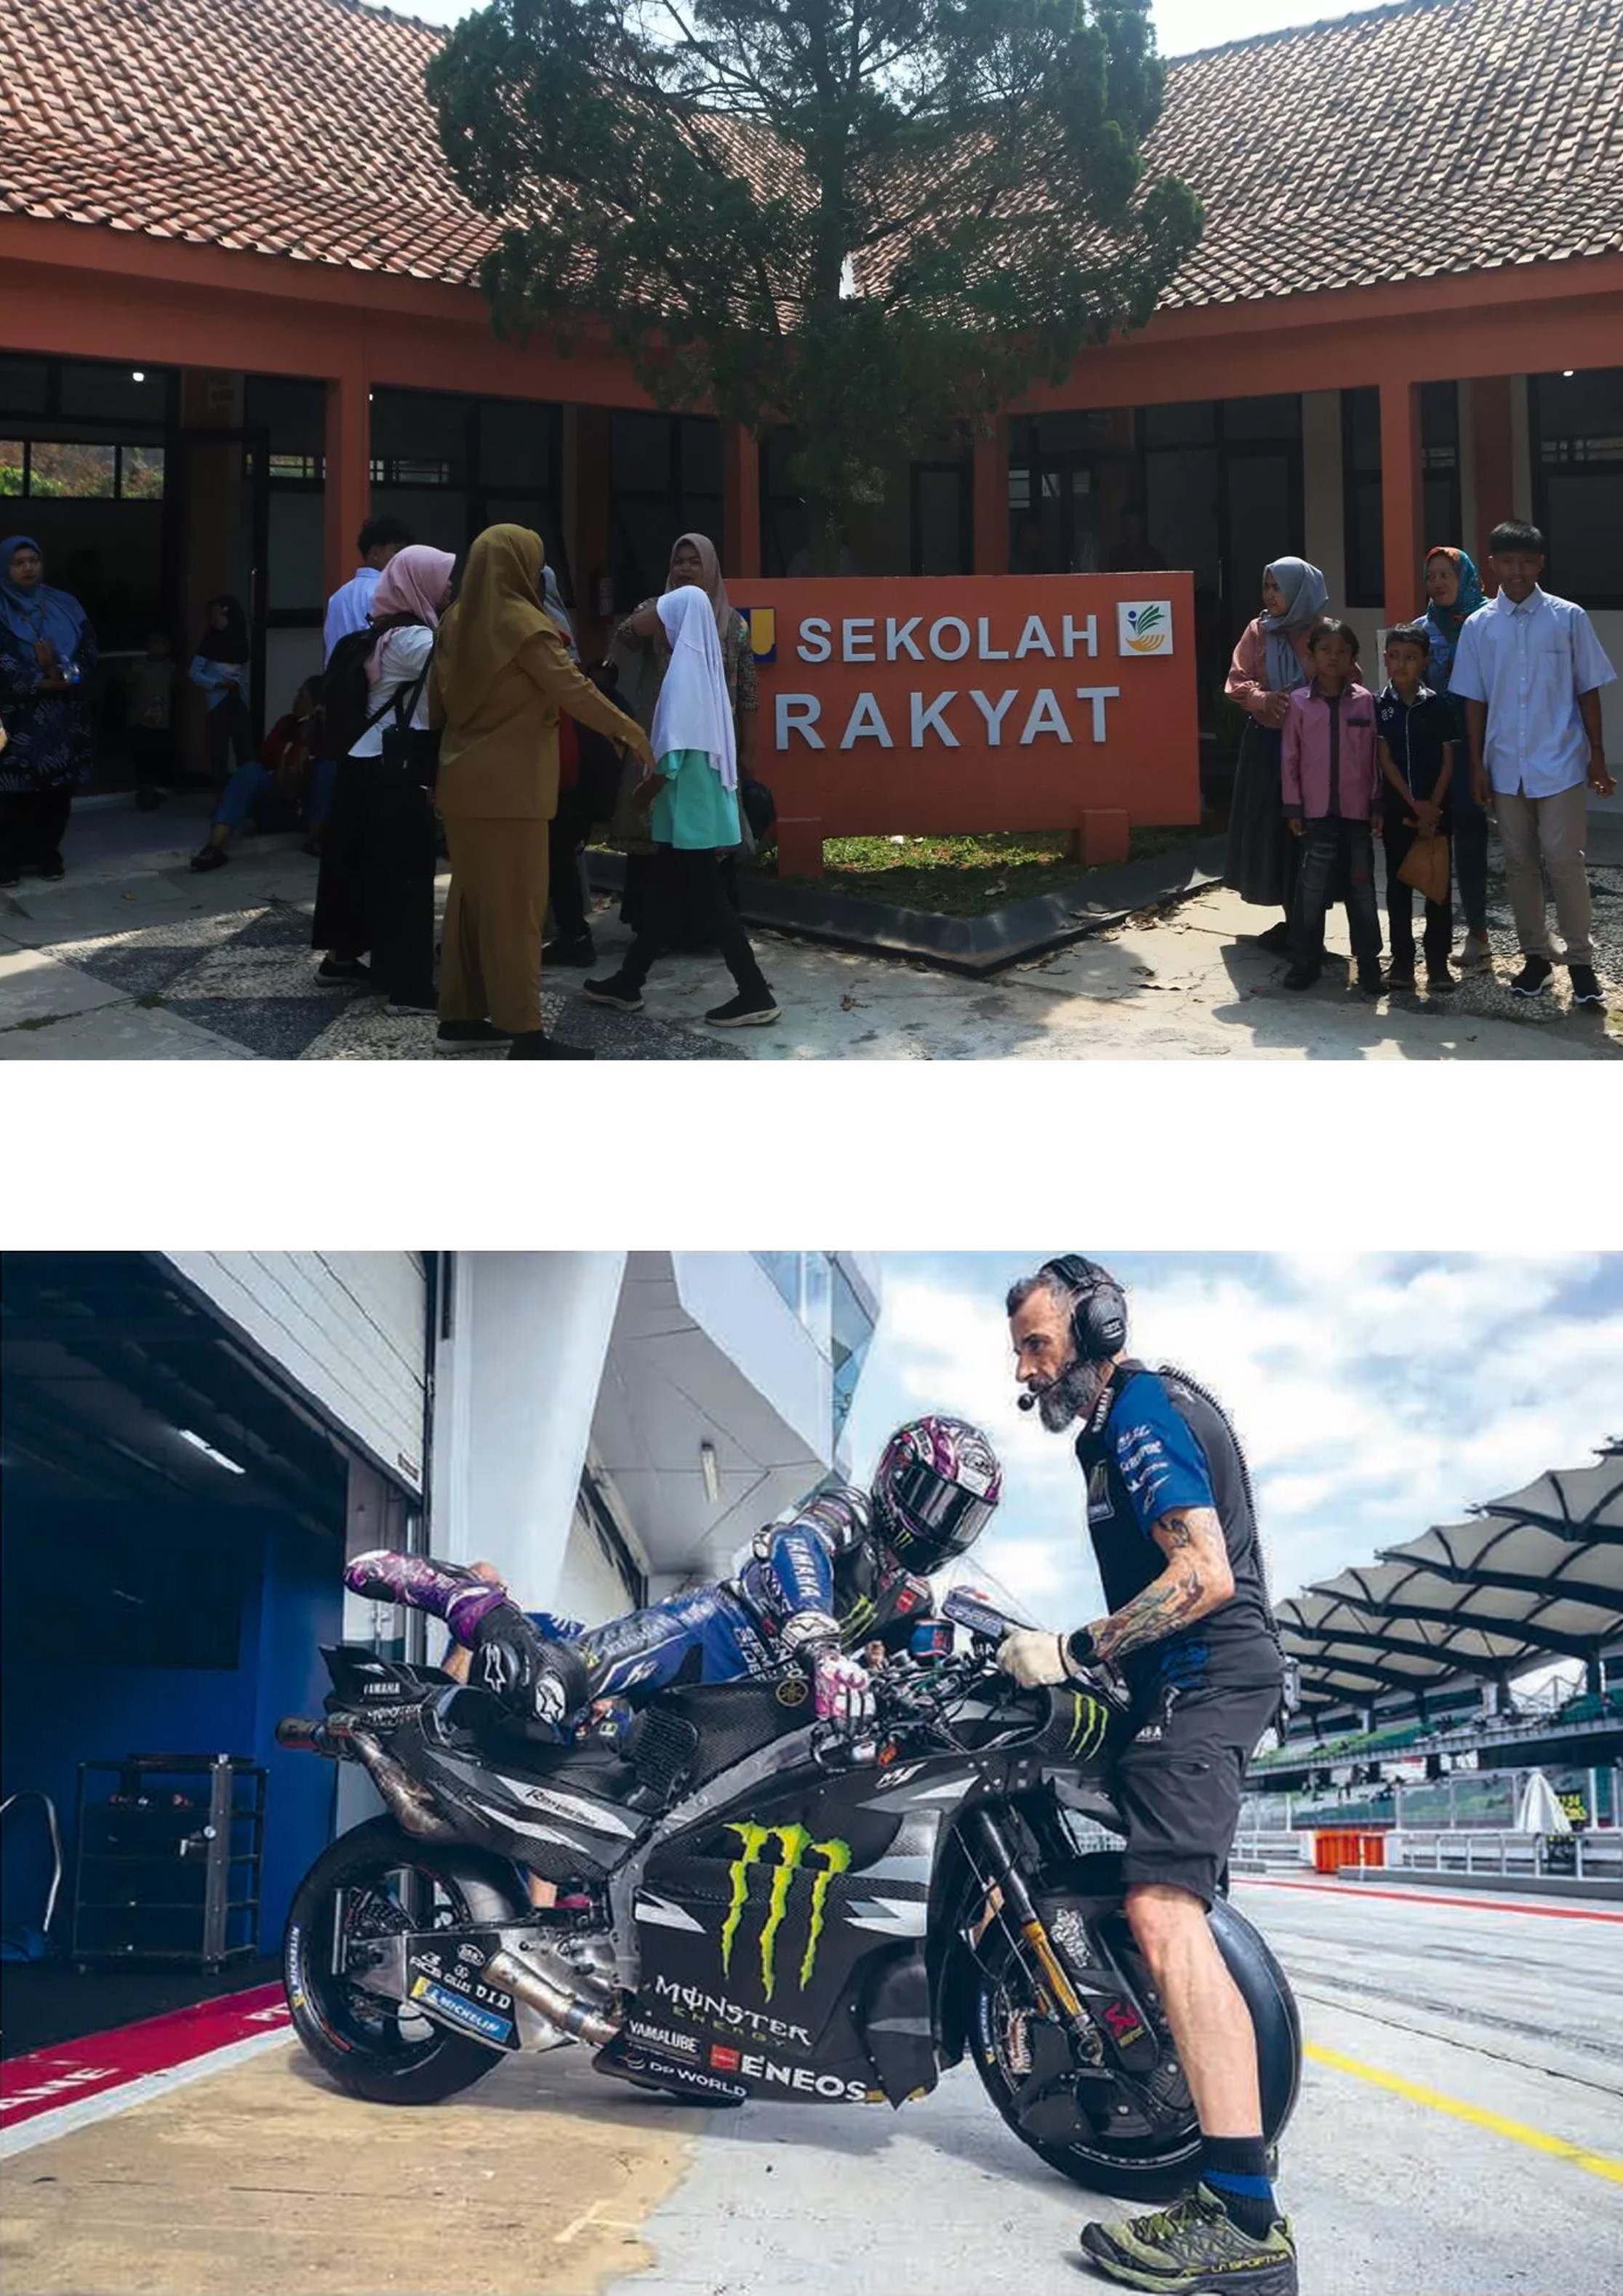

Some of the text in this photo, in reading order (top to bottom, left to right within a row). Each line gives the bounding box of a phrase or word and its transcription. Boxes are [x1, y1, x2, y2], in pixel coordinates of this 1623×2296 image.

[797, 615, 1098, 663] SEKOLAH
[775, 687, 1120, 750] RAKYAT
[439, 1996, 500, 2031] MICHELIN
[655, 1975, 812, 2047] MONSTER
[629, 2020, 701, 2053] YAMALUBE
[677, 2068, 747, 2097] WORLD
[741, 2055, 867, 2100] ENEOS
